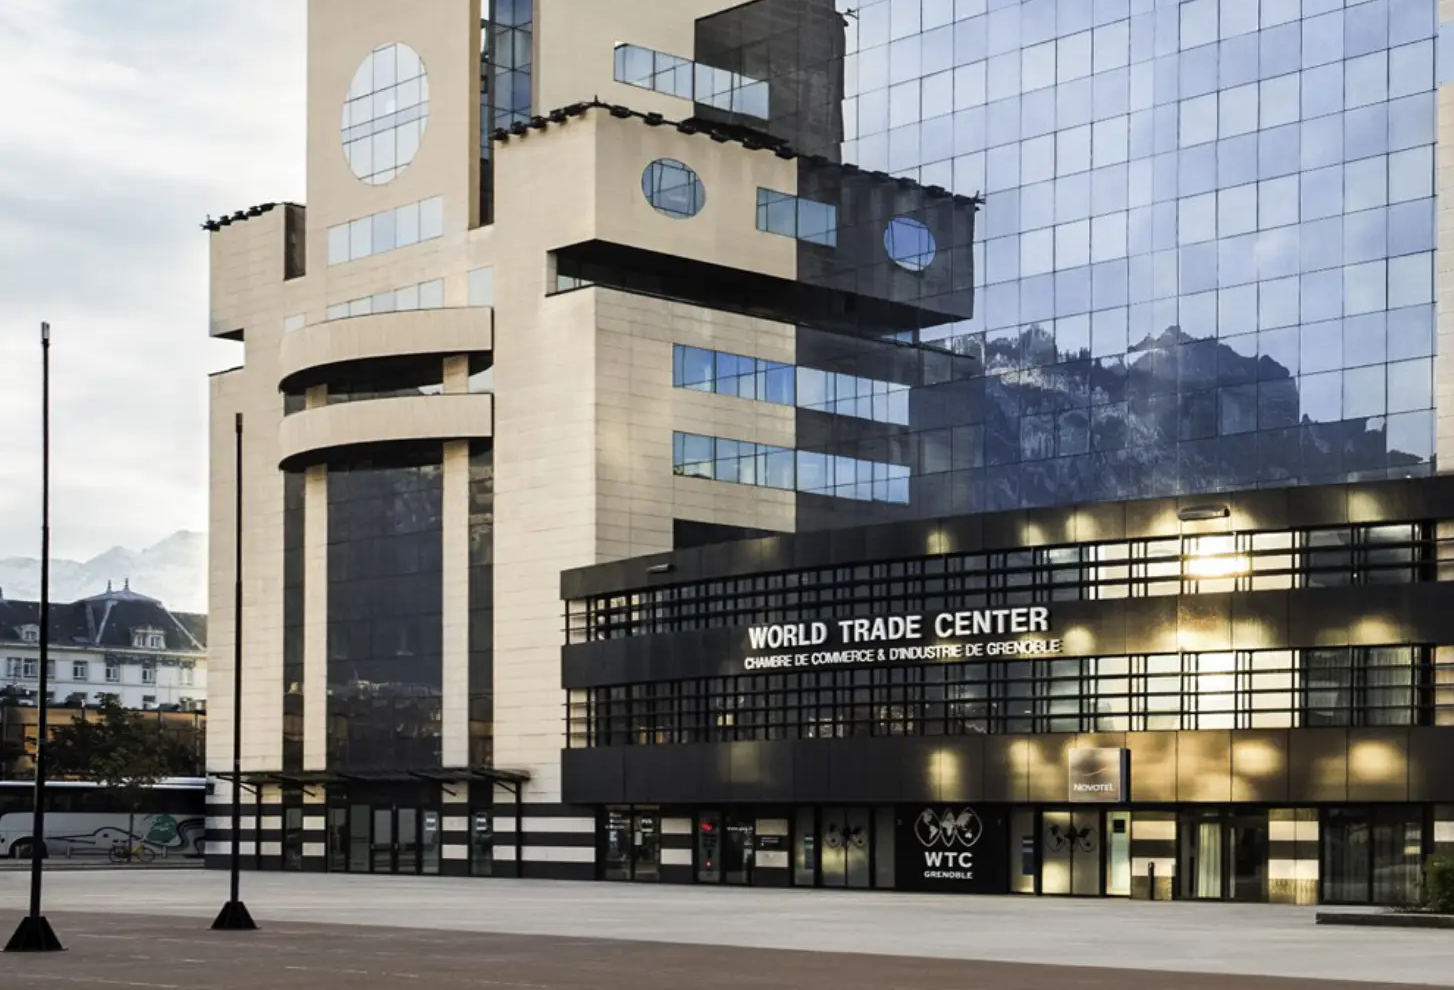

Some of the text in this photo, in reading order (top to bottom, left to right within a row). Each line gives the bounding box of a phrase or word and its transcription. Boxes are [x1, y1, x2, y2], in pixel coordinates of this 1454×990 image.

[748, 606, 1049, 649] WORLD TRADE CENTER
[744, 639, 1061, 670] CHAMBRE DE COMMERCE & D'INDUSTRIE DE GRENOBLE
[1073, 783, 1116, 792] NOVOTEL
[924, 851, 973, 868] WTC
[924, 870, 973, 879] GRENOBLE
